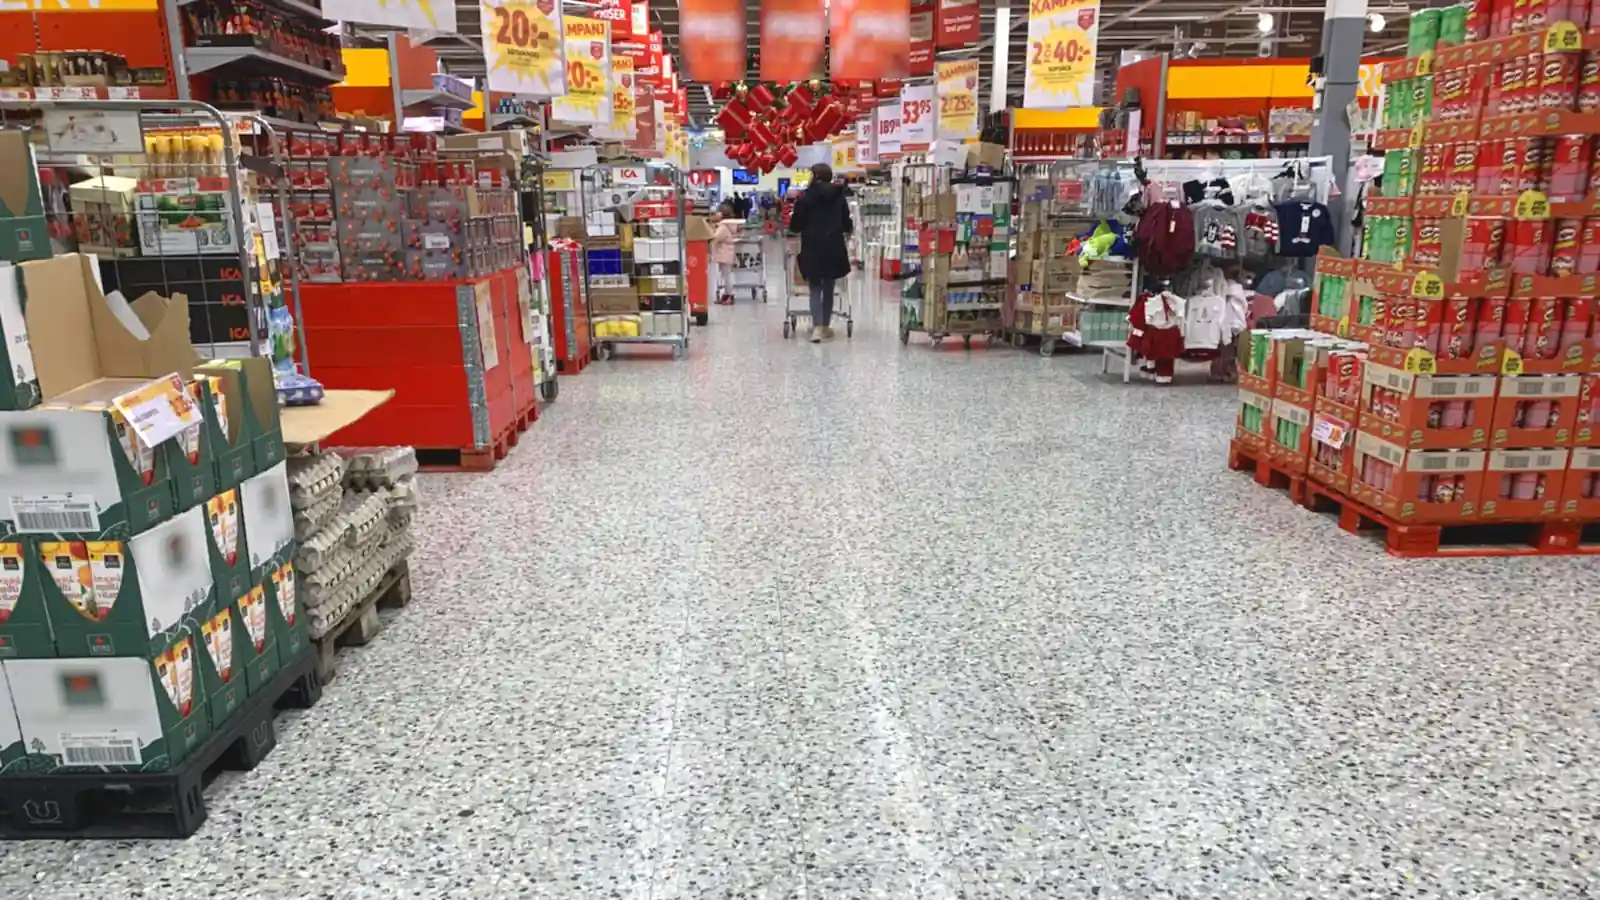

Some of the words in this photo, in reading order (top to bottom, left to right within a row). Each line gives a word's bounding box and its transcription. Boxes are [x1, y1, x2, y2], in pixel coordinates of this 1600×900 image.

[495, 6, 549, 47] 20:-
[1032, 41, 1043, 65] 2
[1053, 39, 1091, 64] 40:-
[567, 60, 599, 89] 0:-
[620, 168, 638, 179] ICA
